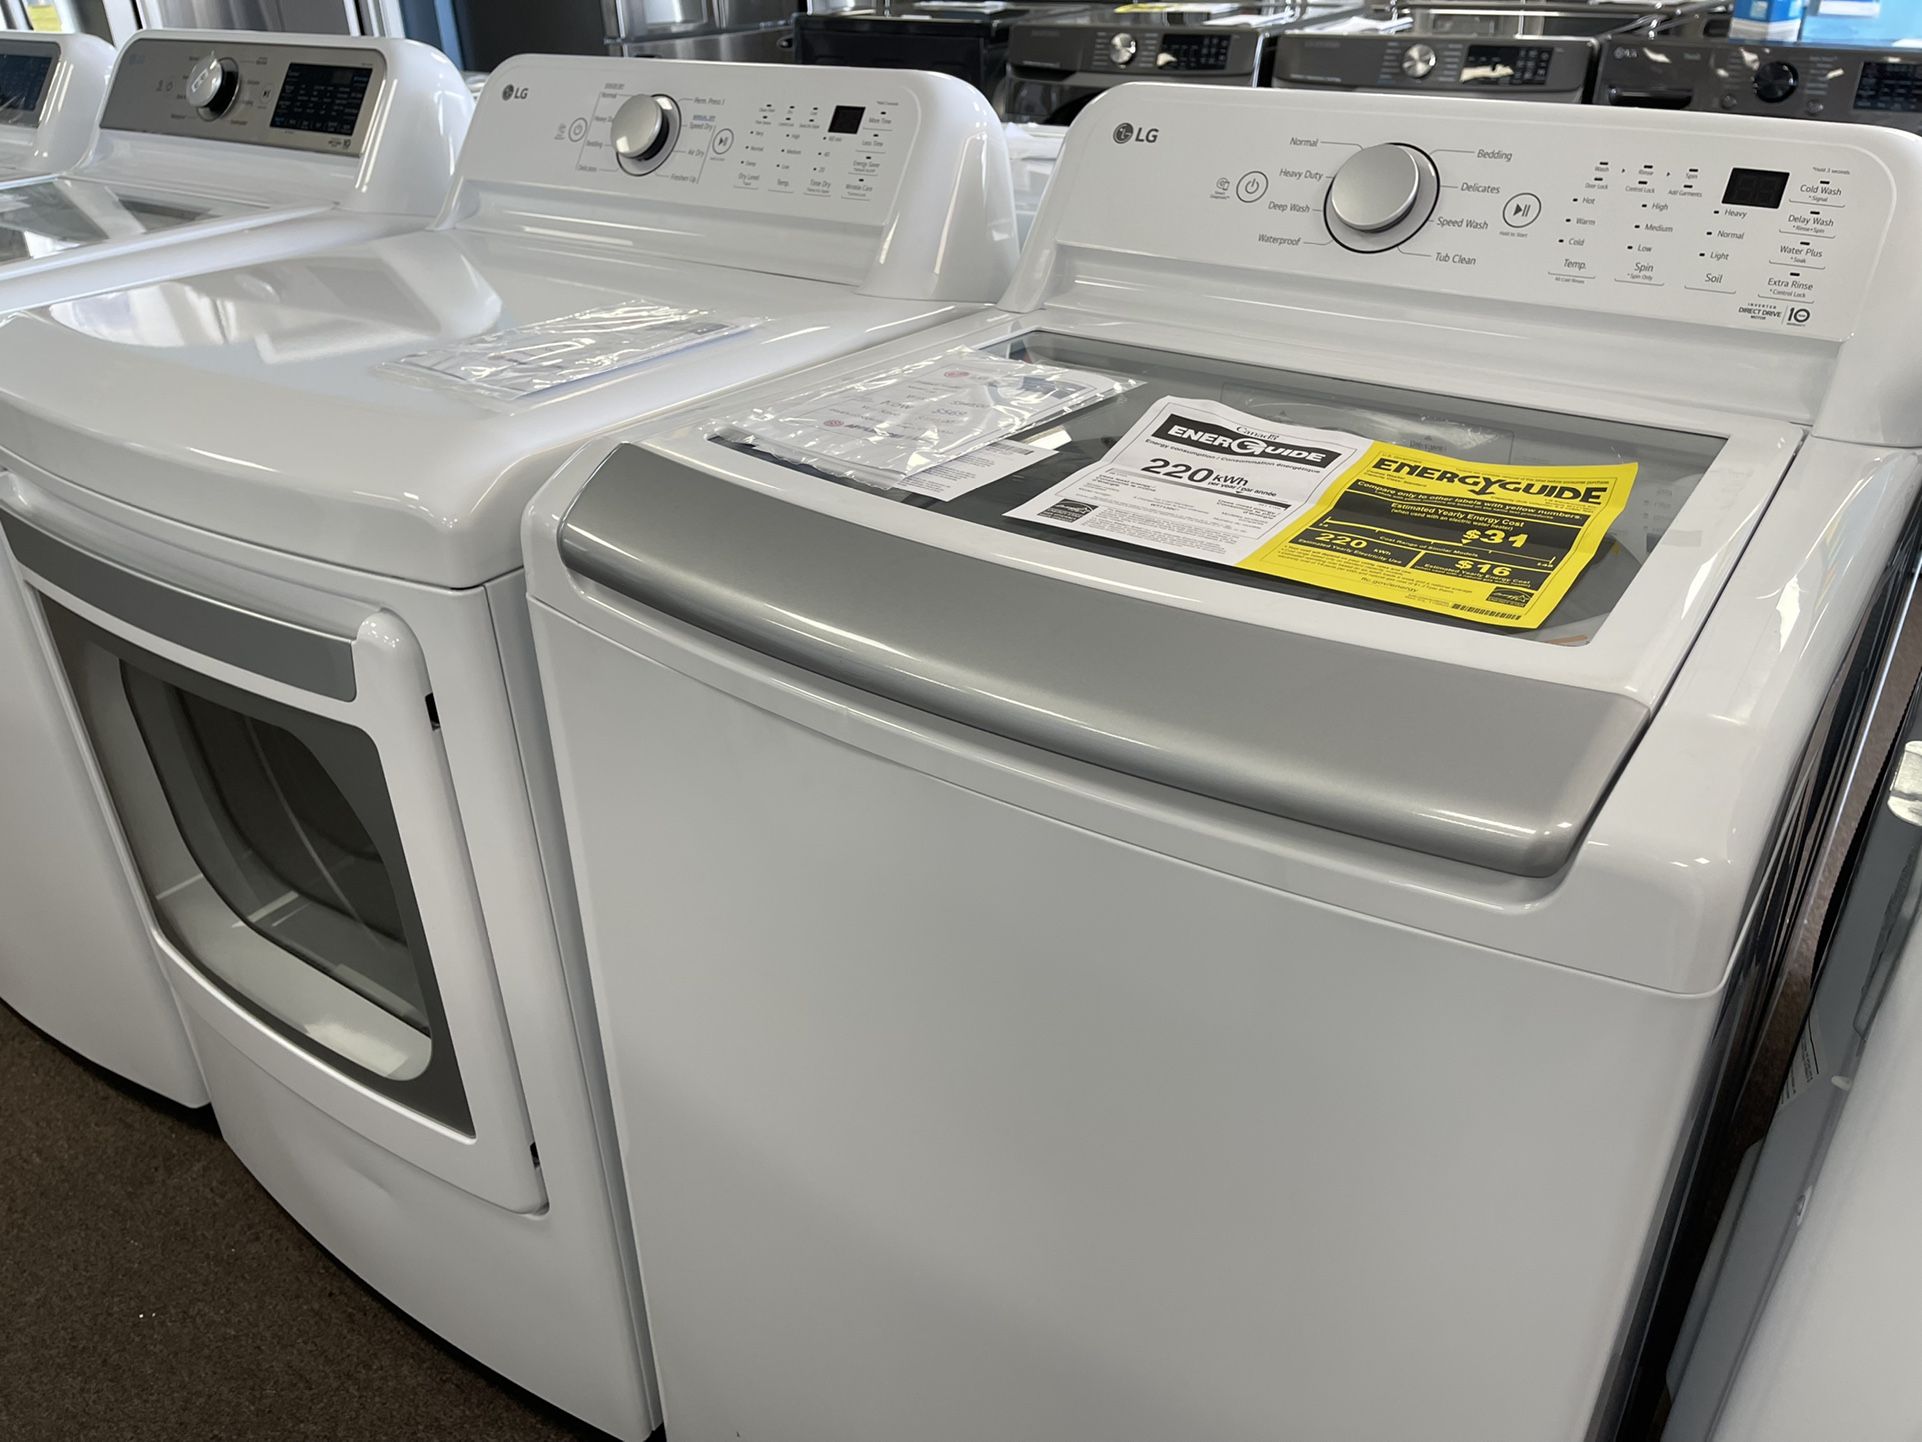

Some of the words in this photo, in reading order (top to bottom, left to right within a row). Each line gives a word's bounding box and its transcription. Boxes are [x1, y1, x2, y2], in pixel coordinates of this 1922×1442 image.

[514, 87, 529, 100] LG
[1135, 127, 1160, 144] LG
[1290, 137, 1318, 147] Normal
[1477, 149, 1512, 162] Bedding
[1280, 168, 1304, 180] Heavy
[1304, 170, 1323, 180] Duty
[1460, 182, 1500, 194] Delicates
[1800, 184, 1818, 194] Cold
[1820, 186, 1842, 196] Wash
[1268, 202, 1288, 212] Deep
[1290, 204, 1310, 213] Wash
[1652, 203, 1668, 212] High
[1724, 209, 1748, 218] Heavy
[1437, 216, 1464, 228] Speed
[1466, 219, 1488, 230] Wash
[1788, 214, 1811, 226] Delay
[1812, 217, 1834, 227] Wash
[1644, 224, 1674, 232] Medium
[1258, 234, 1301, 246] Waterproof
[1717, 230, 1744, 240] Normal
[1568, 238, 1584, 246] Cold
[1638, 244, 1652, 252] Low
[1710, 252, 1729, 261] Light
[1780, 245, 1803, 256] Water
[1804, 248, 1823, 258] Plus
[1436, 252, 1450, 262] Tub
[1452, 254, 1476, 265] Clean
[1564, 259, 1586, 270] Temp.
[1634, 262, 1654, 272] Spin
[1705, 273, 1722, 284] Soil
[1768, 278, 1789, 288] Extra
[1790, 280, 1814, 290] Rinse
[1738, 307, 1762, 316] DIRECT
[1762, 309, 1782, 318] DRIVE
[1788, 307, 1810, 323] 10
[1168, 424, 1327, 463] ENERGUIDE
[1145, 438, 1169, 450] Energy
[1170, 446, 1216, 461] consumption
[1221, 457, 1275, 467] Consommation
[1140, 458, 1215, 484] 220
[1212, 474, 1249, 486] kWh
[1372, 457, 1608, 506] ENERGYGUIDE
[1220, 483, 1236, 492] year
[1241, 486, 1253, 495] par
[1253, 489, 1276, 498] année
[1358, 480, 1396, 496] Compare
[1398, 490, 1418, 499] only
[1429, 494, 1454, 502] other
[1455, 498, 1482, 506] labels
[1505, 504, 1536, 513] yellow
[1538, 509, 1582, 520] numbers.
[1391, 502, 1436, 514] Estimated
[1438, 508, 1464, 520] Yearly
[1466, 513, 1500, 526] Energy
[1502, 519, 1525, 528] Cost
[1391, 508, 1408, 516] (when
[1449, 516, 1472, 524] electric
[1472, 520, 1492, 528] water
[1492, 522, 1514, 532] heater)
[1314, 532, 1368, 548] 220
[1373, 548, 1392, 556] kWh
[1462, 529, 1528, 548] $31
[1298, 539, 1331, 548] Estimated
[1332, 544, 1352, 553] Yearly
[1353, 550, 1388, 562] Electricity
[1396, 538, 1418, 548] Range
[1428, 544, 1452, 553] Similar
[1453, 550, 1479, 558] Models
[1424, 563, 1460, 574] Estimated
[1461, 570, 1484, 578] Yearly
[1484, 574, 1512, 582] Energy
[1454, 560, 1512, 577] $16
